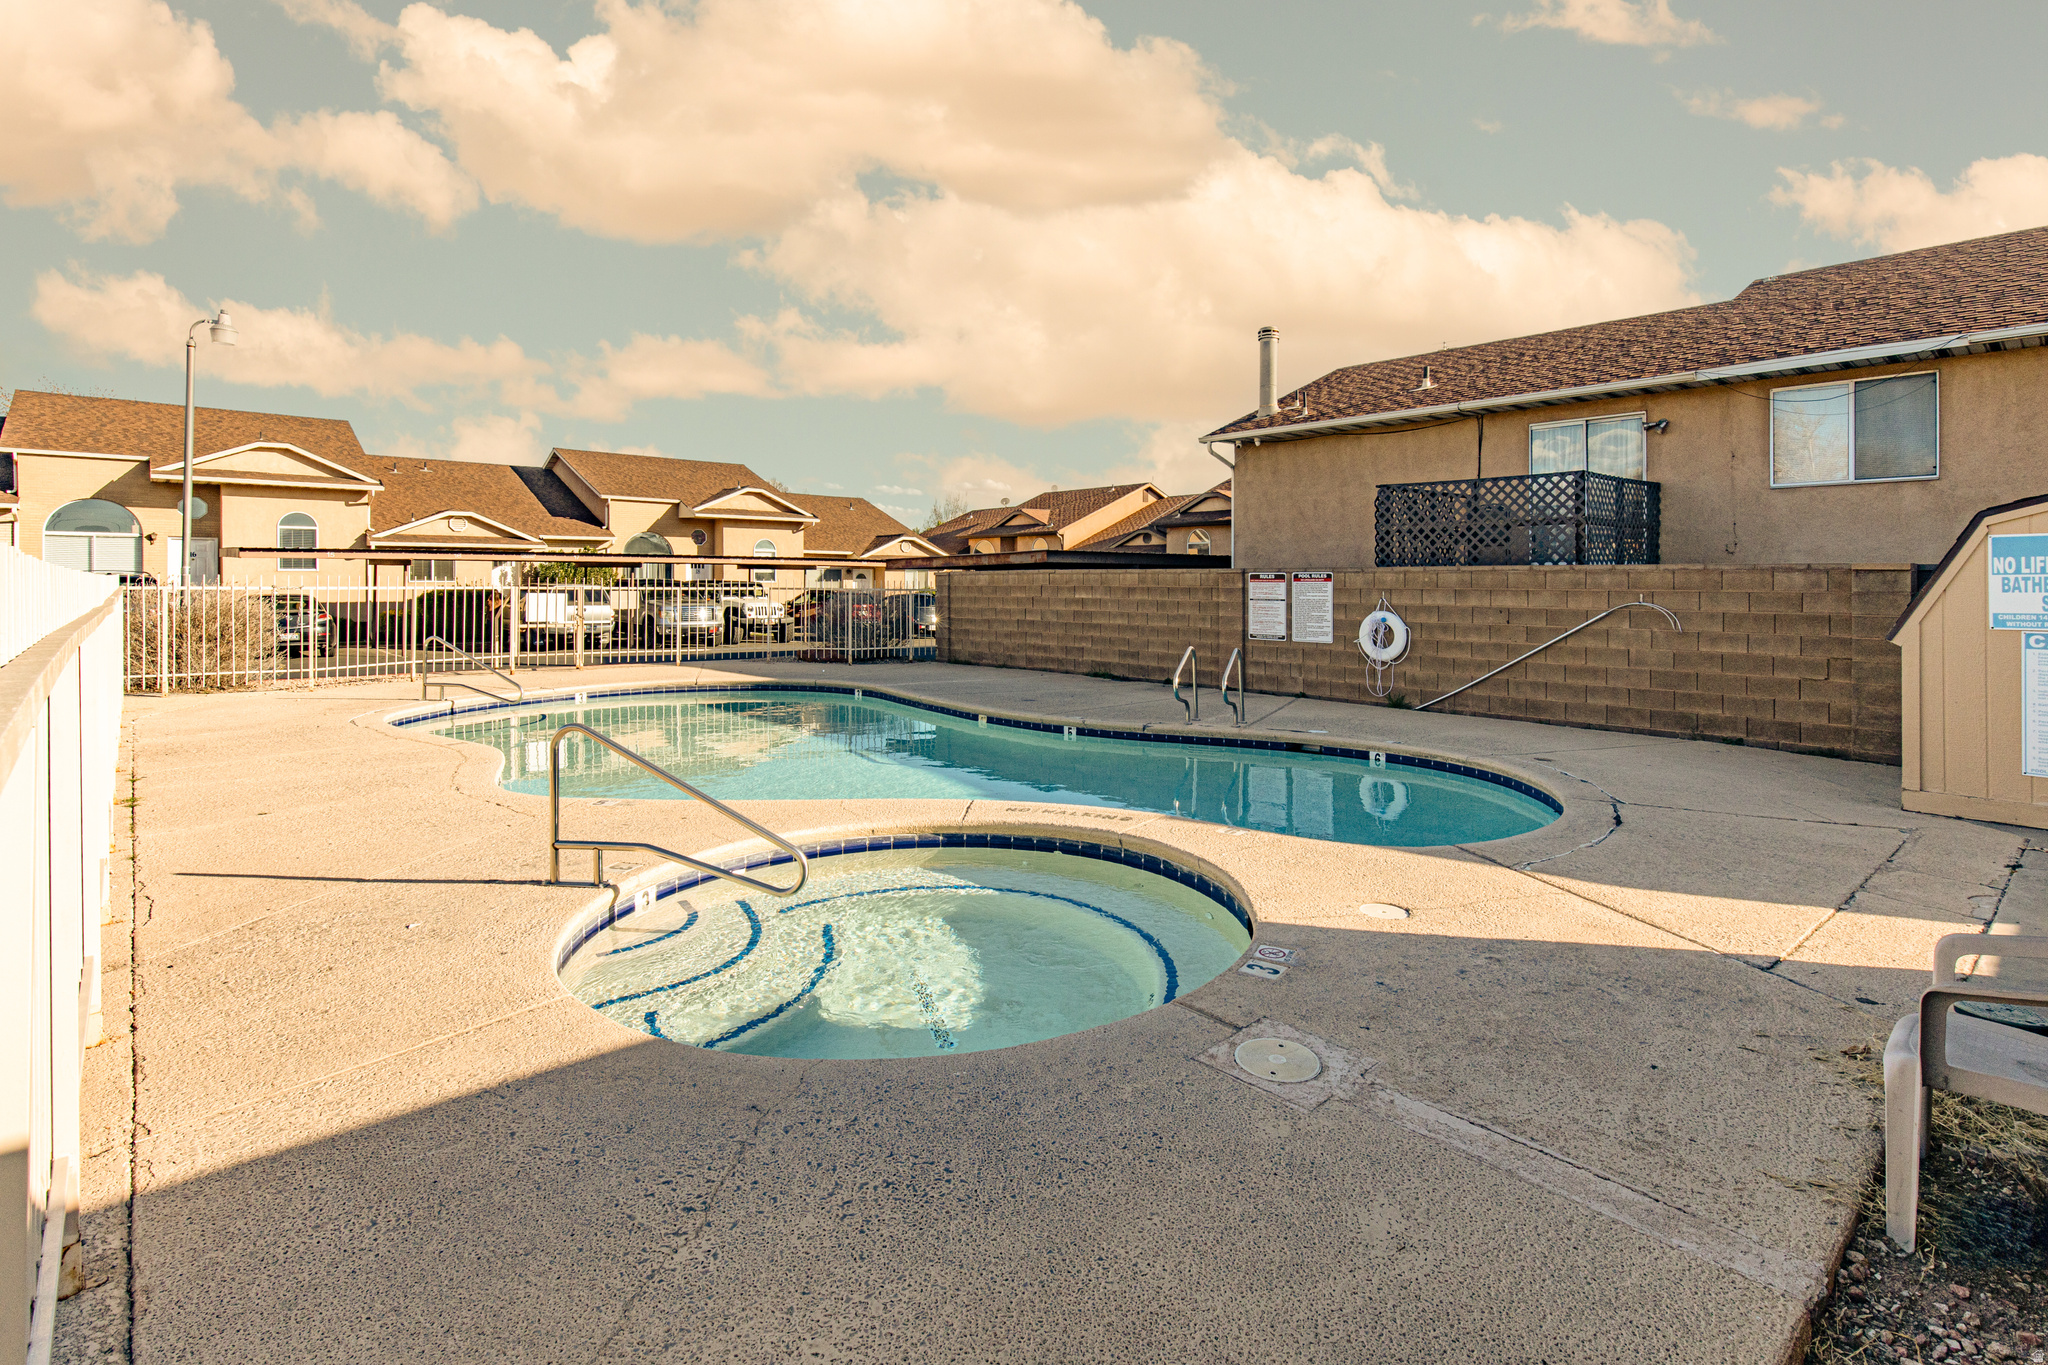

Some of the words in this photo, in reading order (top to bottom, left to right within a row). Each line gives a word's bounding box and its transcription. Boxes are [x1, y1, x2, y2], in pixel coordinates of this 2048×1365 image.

[1993, 556, 2016, 574] NO
[2021, 556, 2048, 574] LIF
[2029, 635, 2048, 648] C
[1246, 964, 1280, 975] 3
